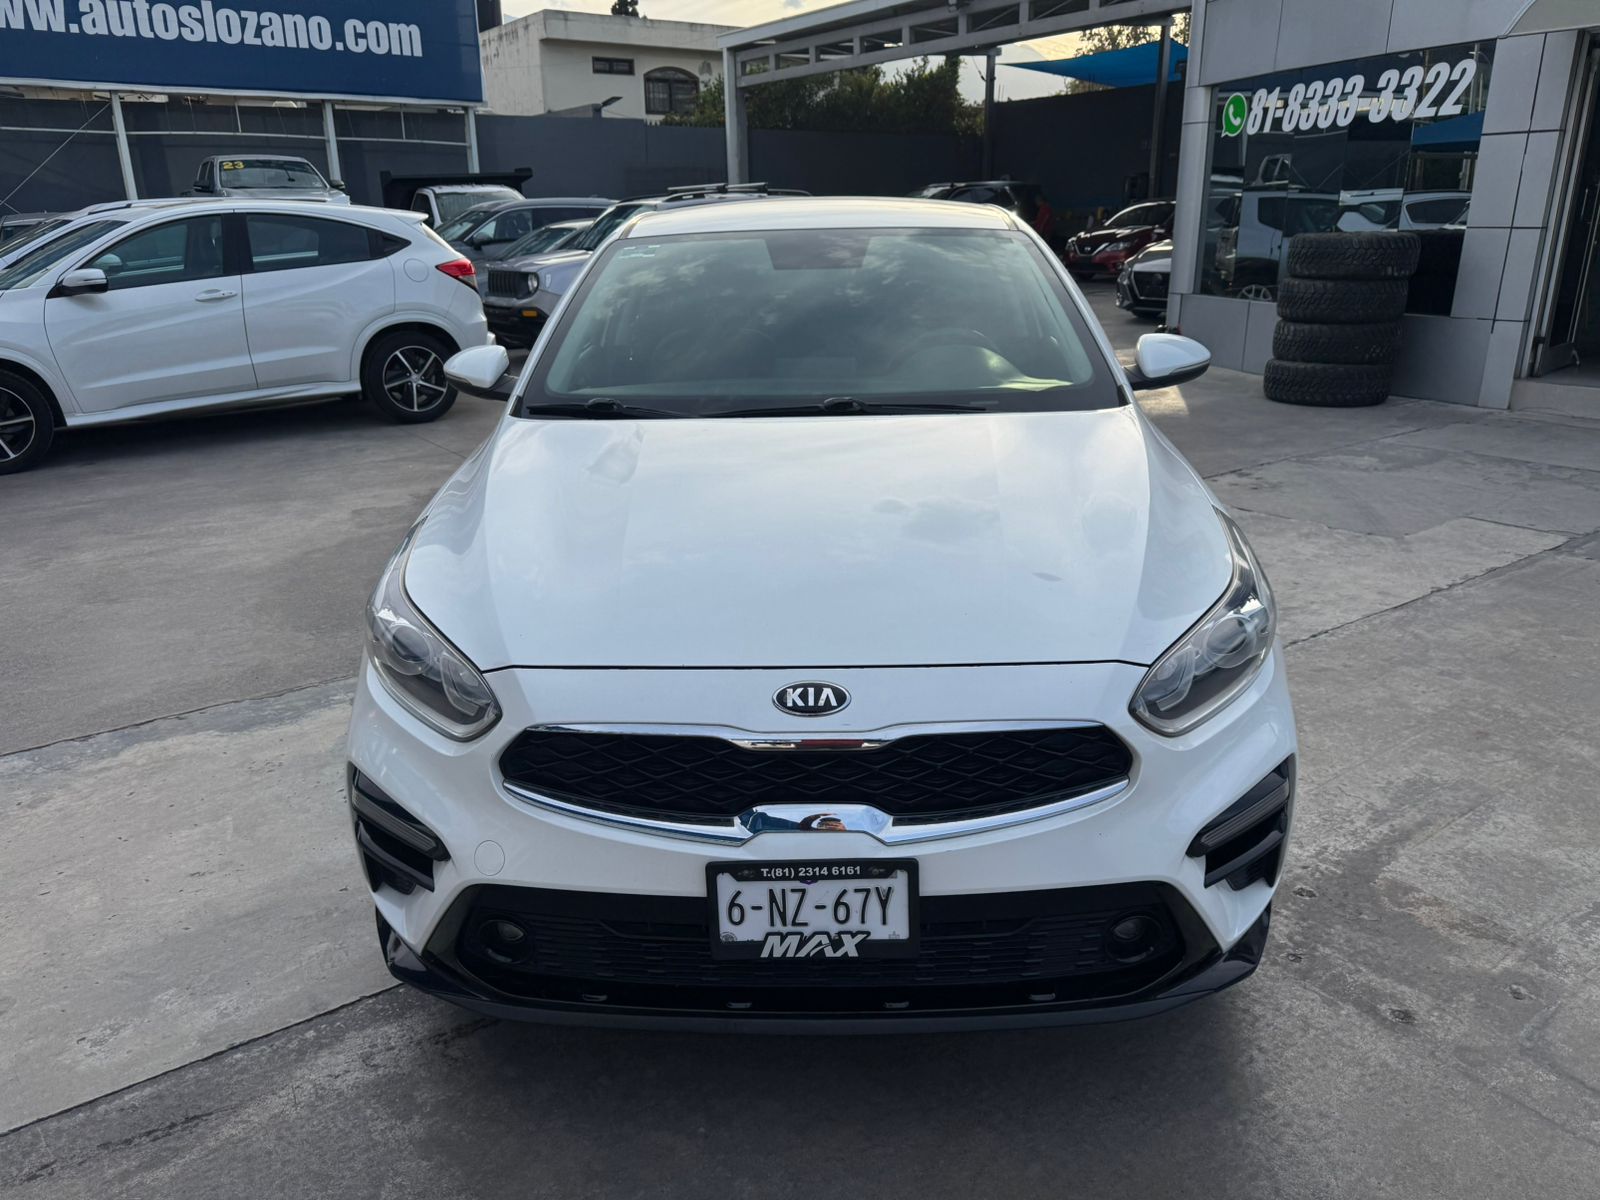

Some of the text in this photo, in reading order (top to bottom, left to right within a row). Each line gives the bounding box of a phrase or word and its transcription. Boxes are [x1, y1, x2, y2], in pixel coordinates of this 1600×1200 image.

[1246, 58, 1477, 136] 81-8333-3322
[222, 161, 245, 170] 23
[786, 687, 838, 707] KIA
[760, 866, 861, 879] T.(81) 2314 6161
[727, 886, 892, 927] 6-NZ-67Y
[760, 932, 869, 958] MAX
